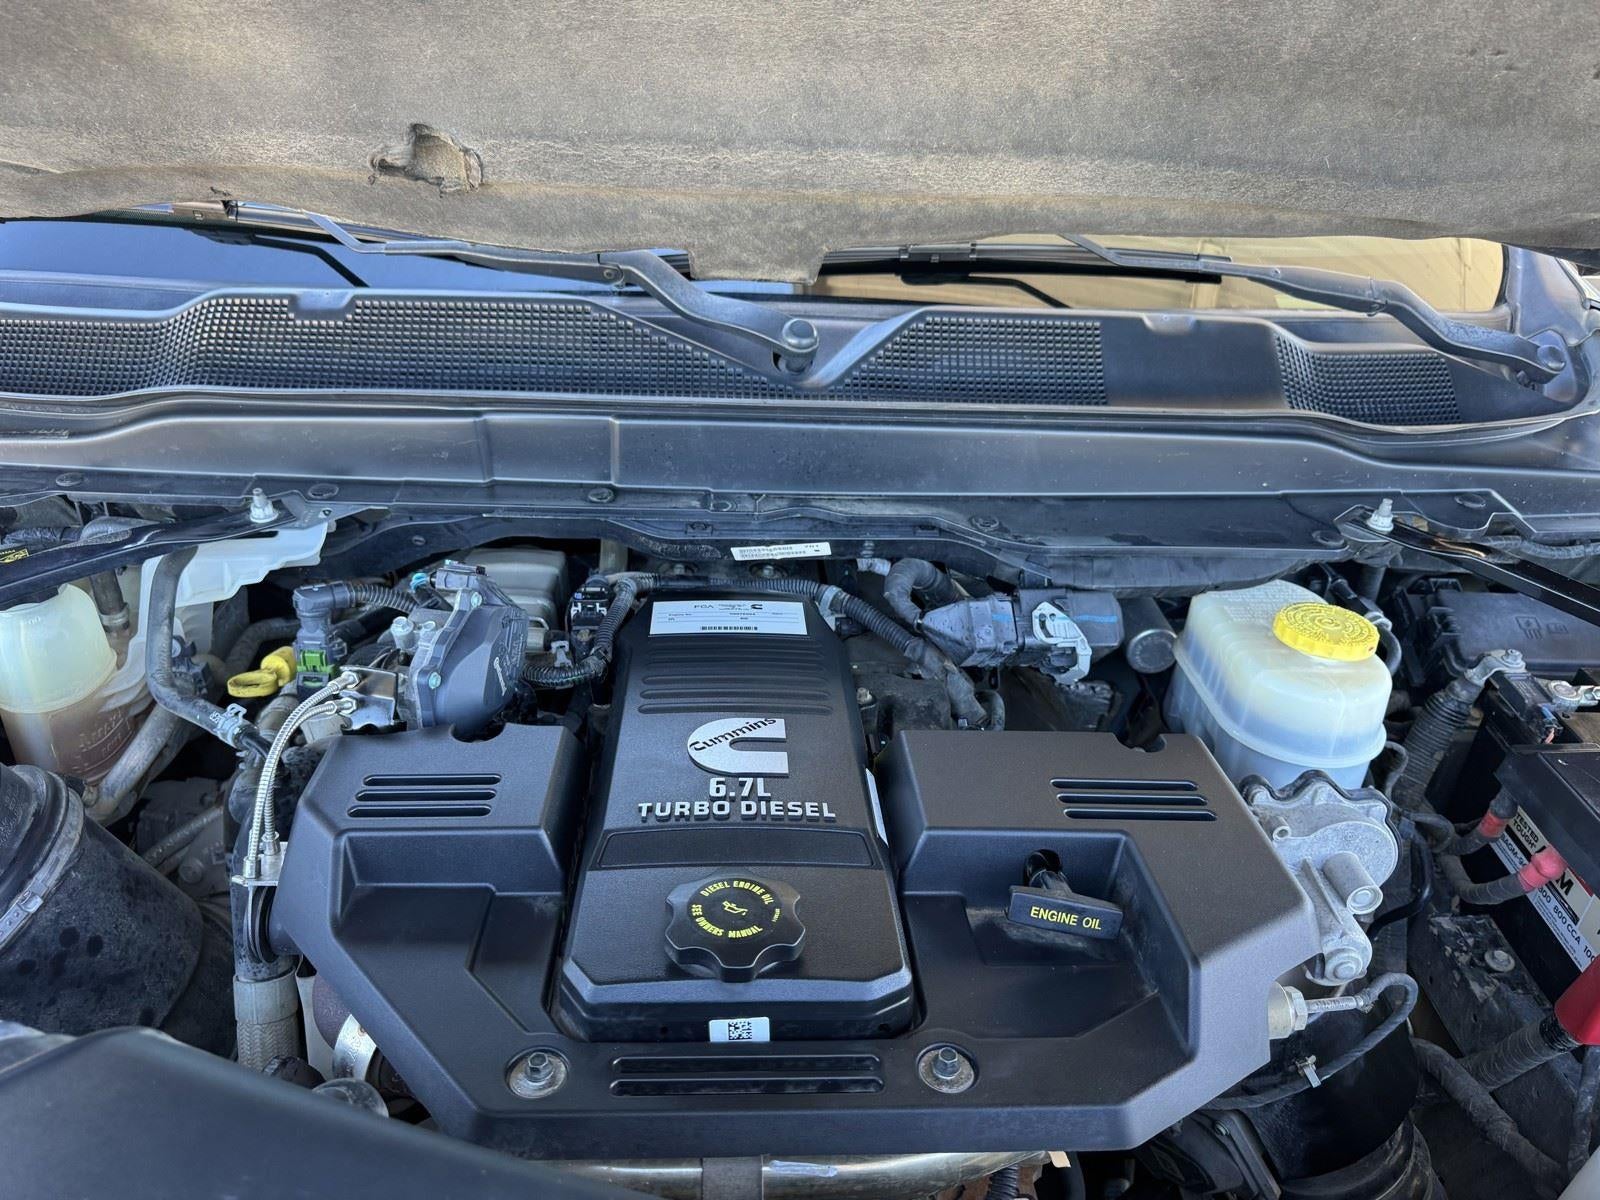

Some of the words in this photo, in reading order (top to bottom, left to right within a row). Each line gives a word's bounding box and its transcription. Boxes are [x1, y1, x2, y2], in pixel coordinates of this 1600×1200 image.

[689, 717, 777, 752] Cummins
[709, 776, 772, 799] 6.7L
[637, 800, 731, 821] TURBO
[740, 800, 837, 822] DIESEL
[1515, 812, 1540, 843] TESTED
[700, 880, 731, 897] DIESEL
[732, 880, 766, 896] ENGINE
[761, 893, 775, 905] OIL
[691, 904, 703, 917] SEE
[727, 924, 764, 939] MANUAL
[1029, 905, 1079, 926] ENGINE
[1082, 916, 1102, 931] OIL
[1552, 904, 1569, 926] 800
[1566, 923, 1582, 946] CCA
